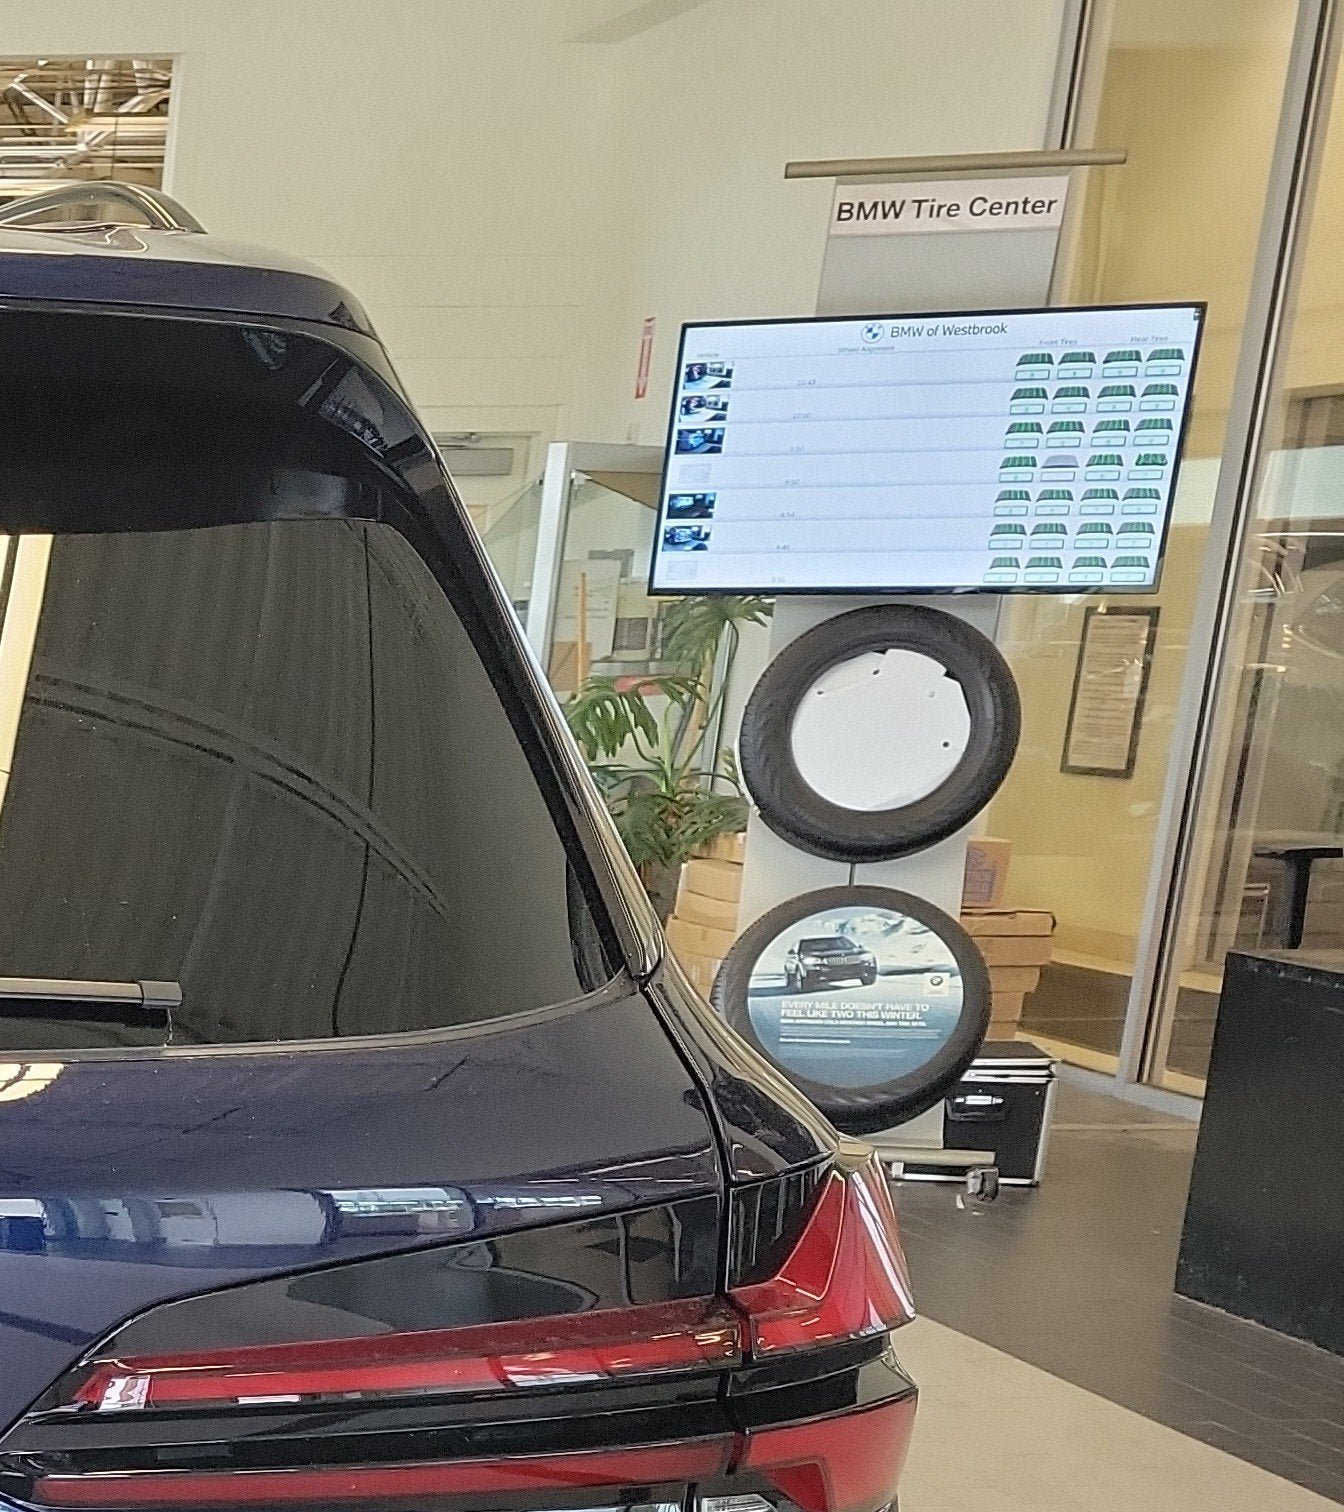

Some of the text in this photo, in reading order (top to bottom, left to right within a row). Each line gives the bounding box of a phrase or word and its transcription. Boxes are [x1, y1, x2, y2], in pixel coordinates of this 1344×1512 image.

[836, 195, 1058, 222] BMW Tire Center
[890, 322, 1008, 338] BMW of Westbrook
[781, 1001, 930, 1012] EVERY MILE DOESN'T HAVE TO
[781, 1008, 922, 1020] FEEL LIKE TWO THIS WINTER.
